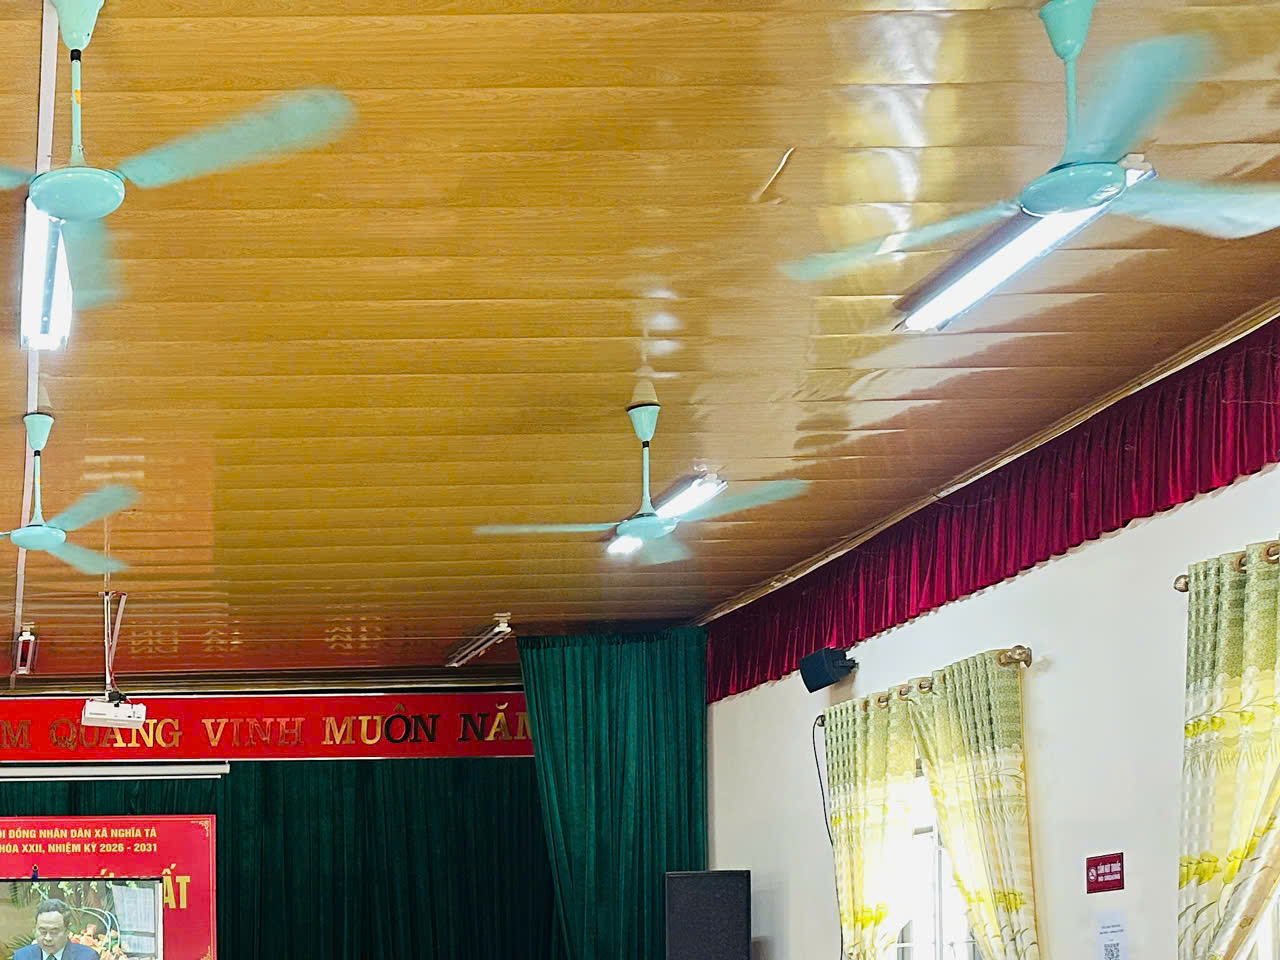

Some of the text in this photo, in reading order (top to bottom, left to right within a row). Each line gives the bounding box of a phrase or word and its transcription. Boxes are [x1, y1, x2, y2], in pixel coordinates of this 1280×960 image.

[48, 717, 183, 751] QUANG
[201, 716, 304, 748] VINH
[322, 703, 440, 746] MUÔN
[39, 827, 68, 839] NHÂN
[70, 827, 92, 838] DÂN
[110, 826, 142, 838] NGHĨA
[22, 843, 45, 854] XXII,
[47, 841, 81, 854] NHIỆM
[99, 843, 124, 853] 2026
[133, 843, 157, 852] 2031
